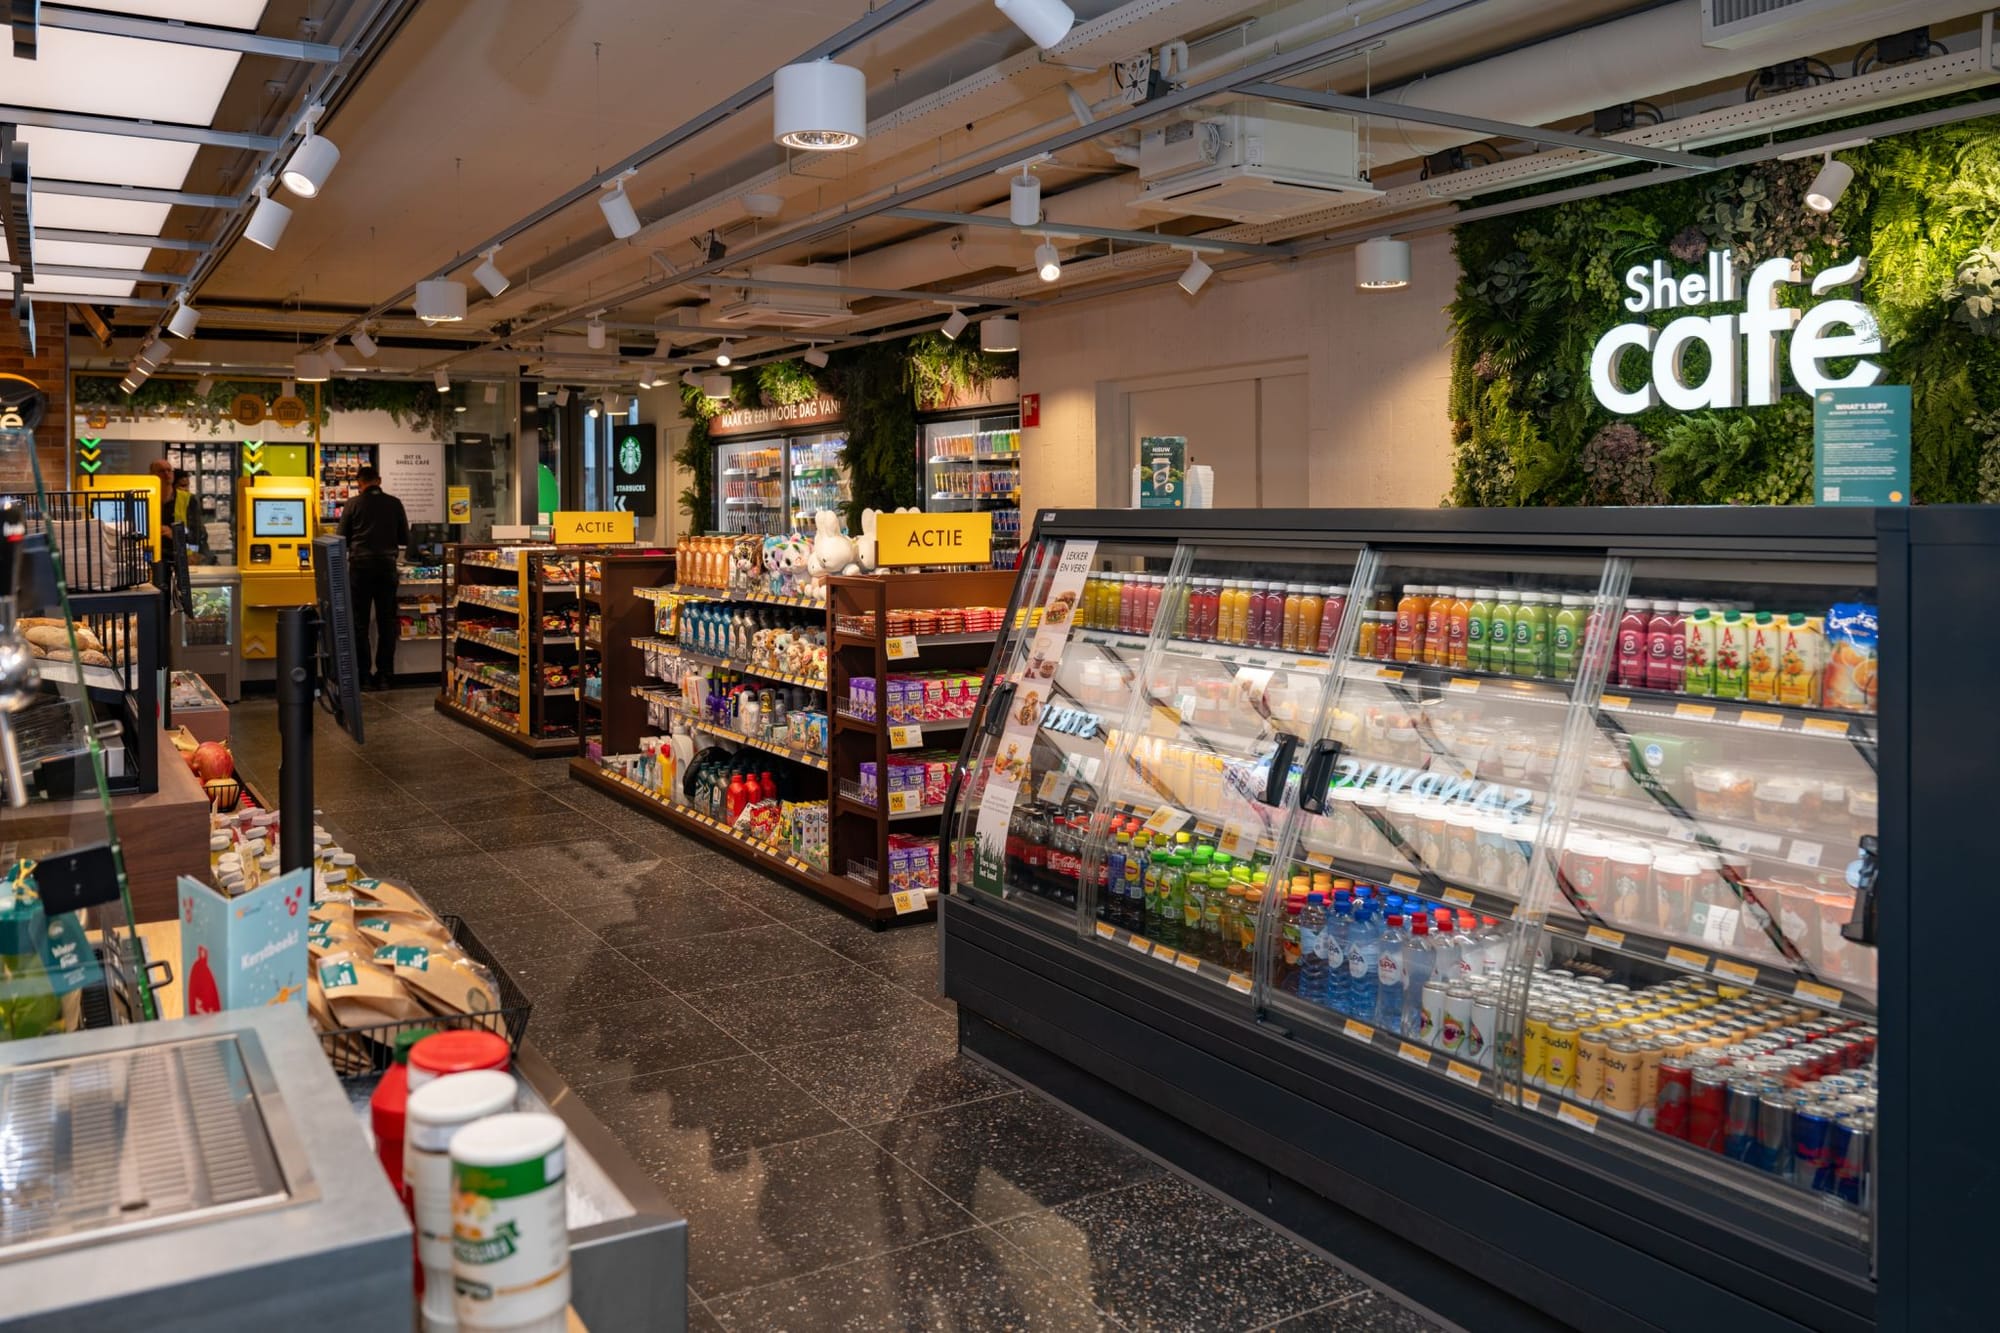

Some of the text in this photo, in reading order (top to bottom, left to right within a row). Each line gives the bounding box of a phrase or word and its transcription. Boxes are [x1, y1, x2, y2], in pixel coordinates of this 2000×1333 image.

[1624, 249, 1732, 313] Shell
[1590, 255, 1882, 414] café
[721, 399, 841, 428] MAAK ER EEN MOOIE DAG VAN!
[616, 484, 647, 492] STARBUCKS
[575, 521, 614, 533] ACTIE
[907, 530, 963, 547] ACTIE
[1065, 551, 1089, 561] LEKKER
[1059, 562, 1069, 572] EN
[1379, 957, 1398, 971] SPA
